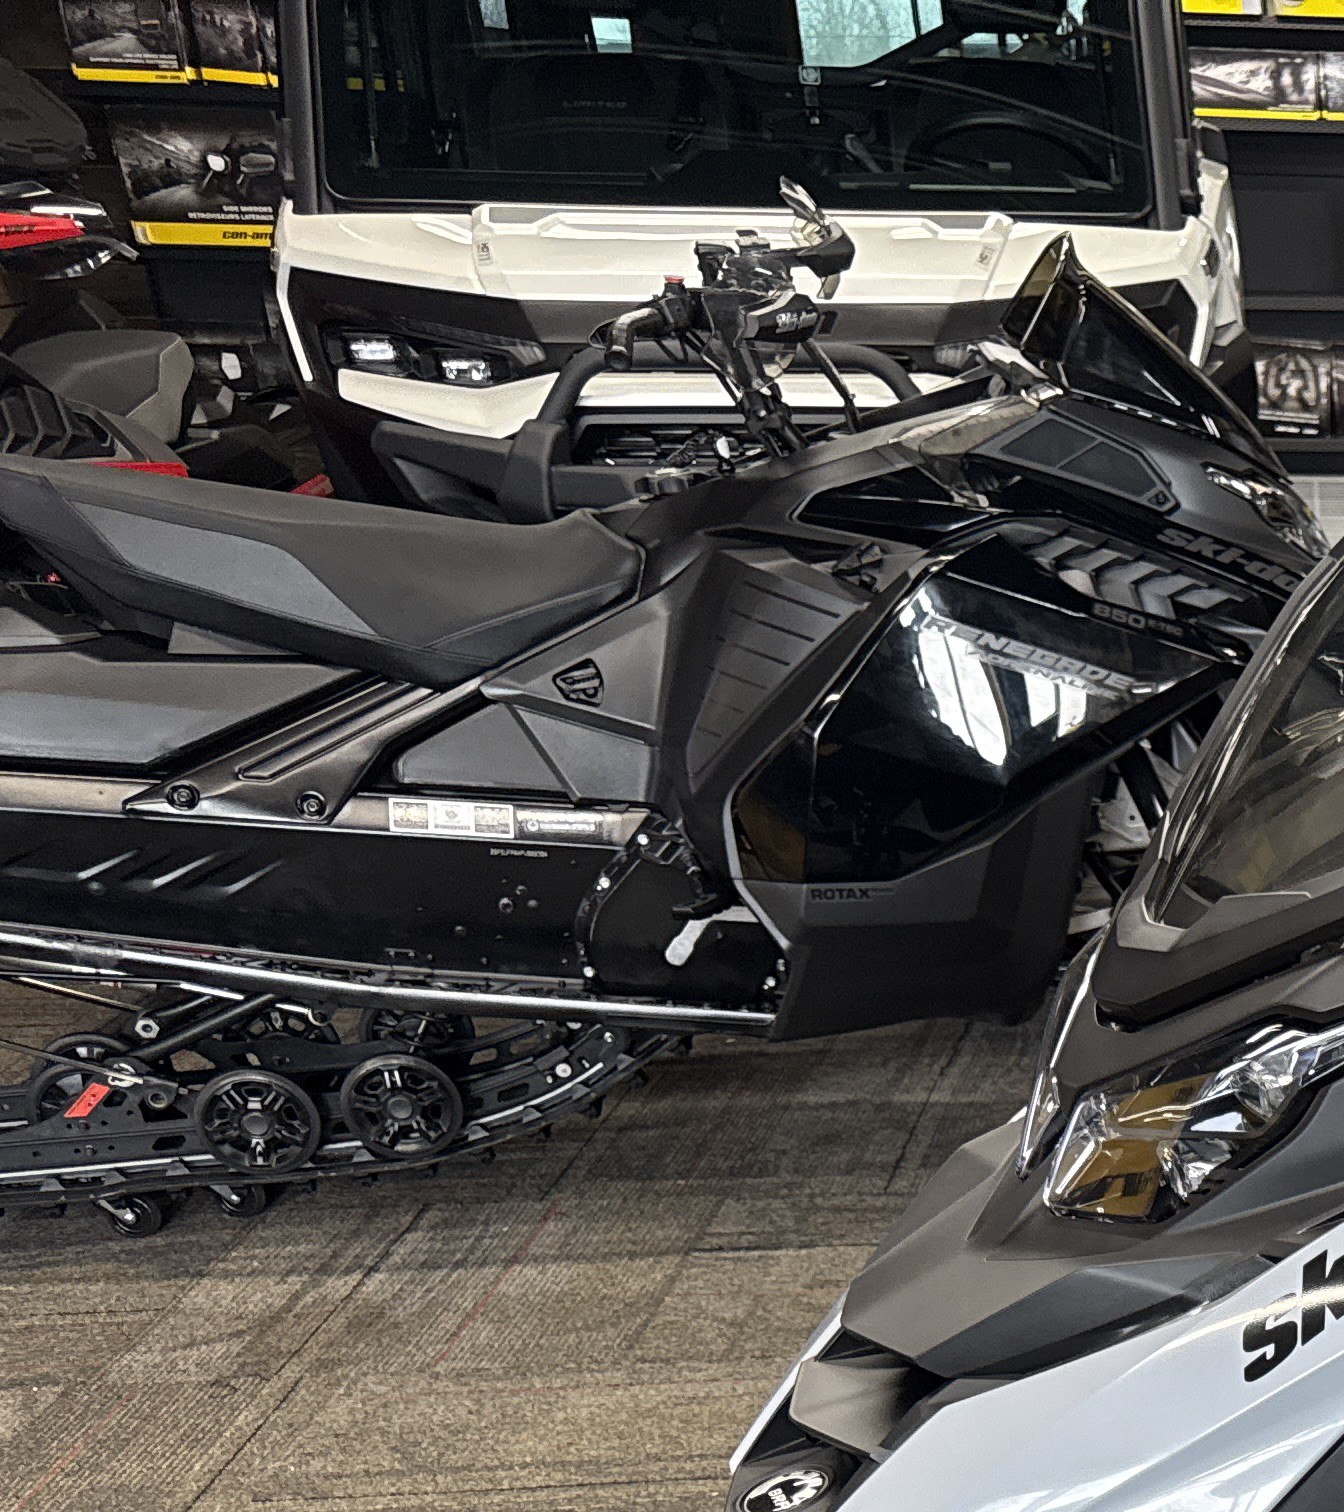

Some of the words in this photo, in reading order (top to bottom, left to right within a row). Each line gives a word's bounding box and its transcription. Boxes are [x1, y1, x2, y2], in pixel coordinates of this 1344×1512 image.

[1093, 602, 1145, 629] 850
[920, 614, 1136, 691] RENEGADE
[811, 888, 870, 900] ROTAX
